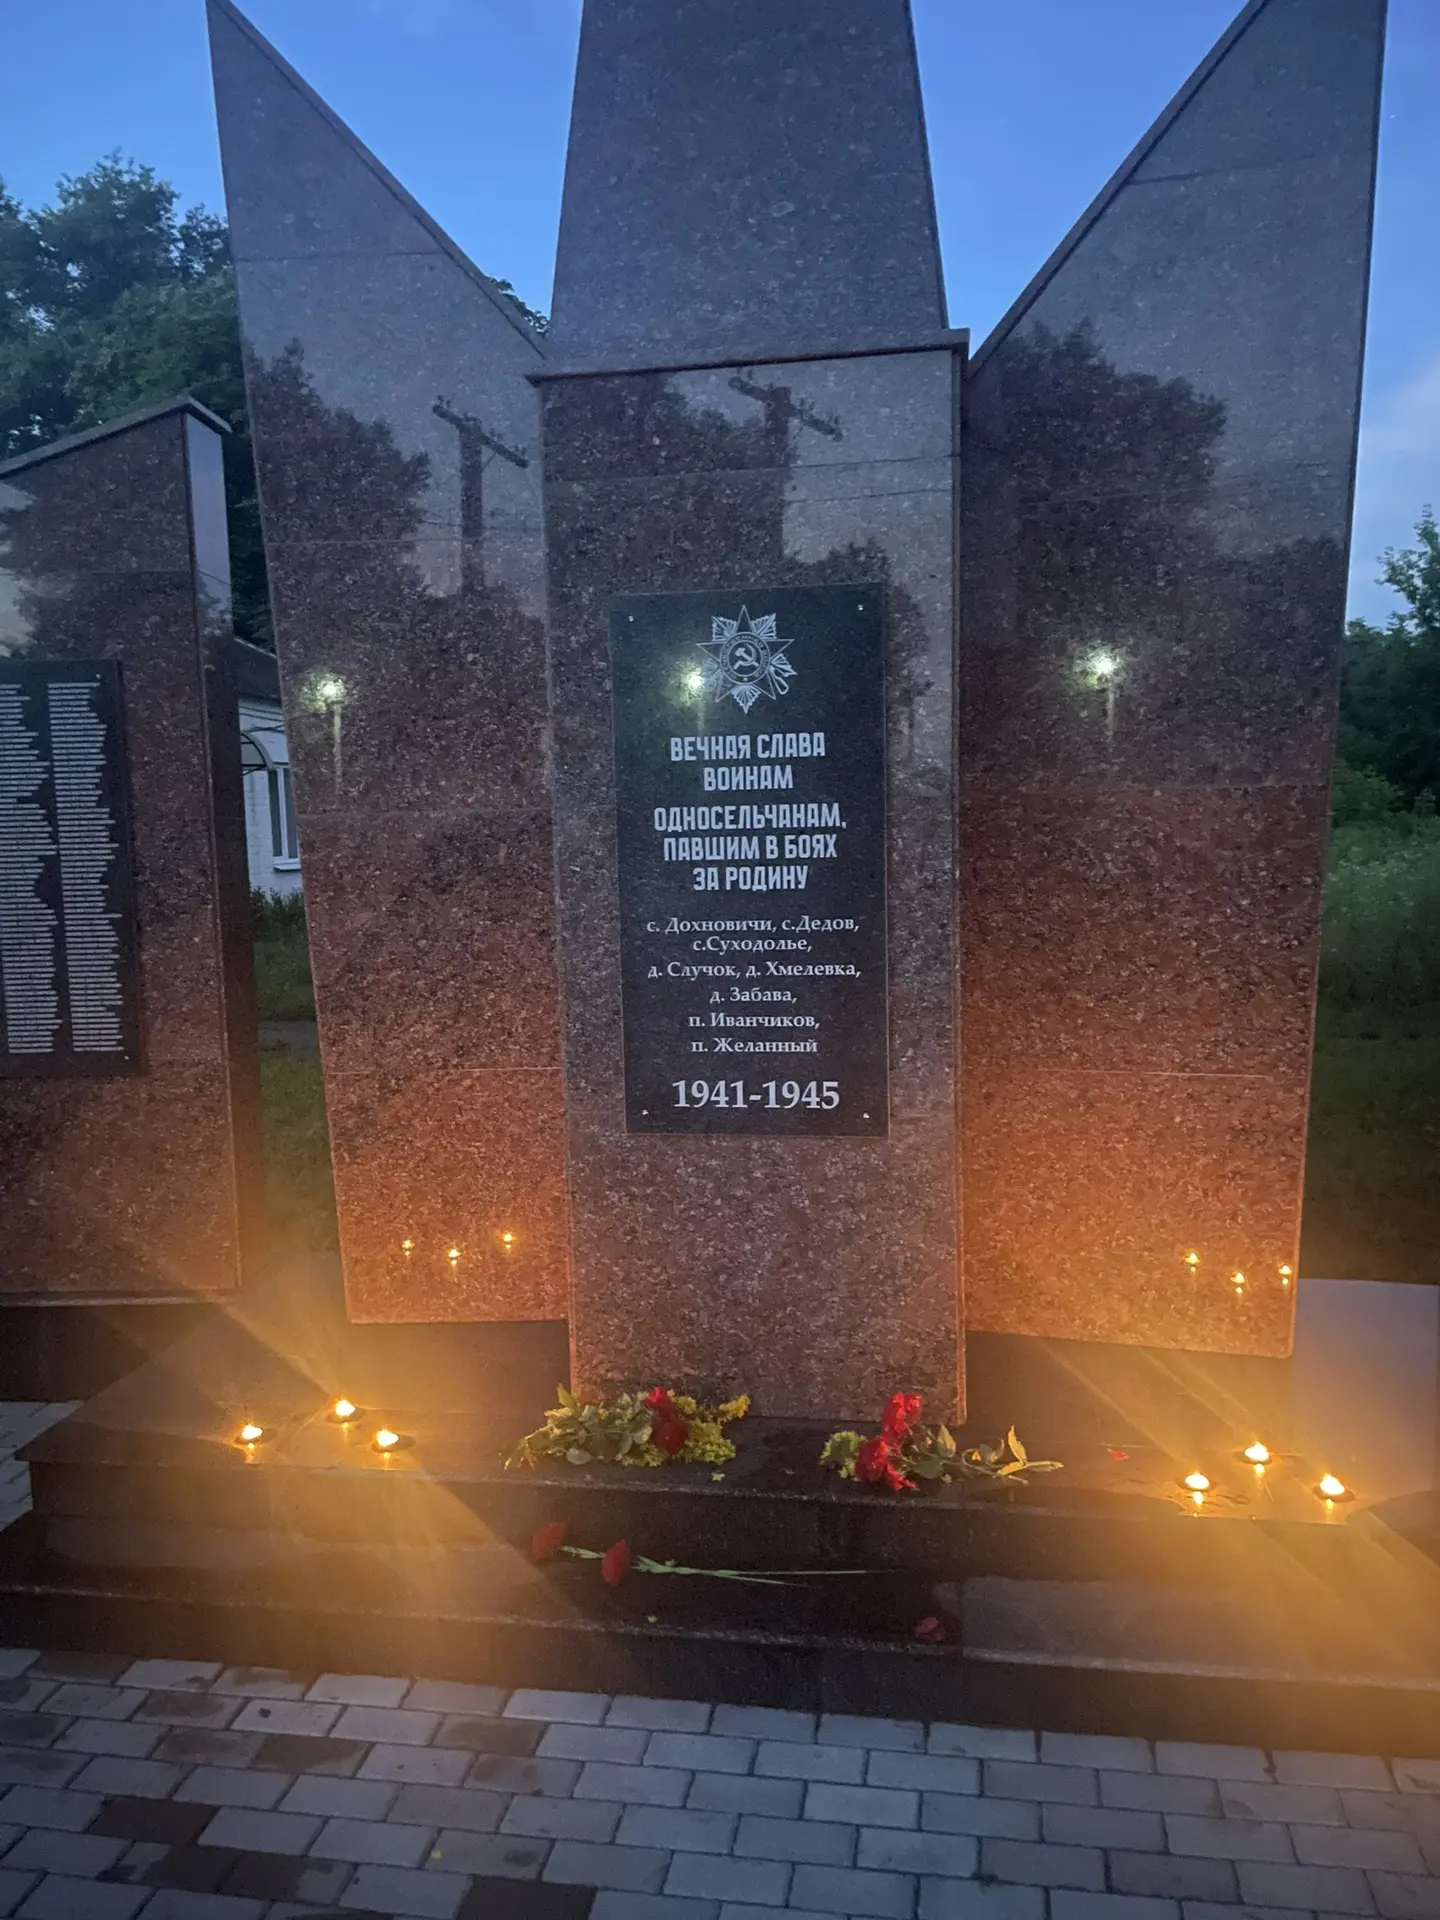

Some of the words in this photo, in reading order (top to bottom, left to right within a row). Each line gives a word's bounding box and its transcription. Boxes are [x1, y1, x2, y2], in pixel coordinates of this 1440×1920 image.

[671, 735, 751, 761] ВЕЧНАЯ
[757, 732, 826, 758] СЛАВА
[703, 765, 794, 791] ВОИНАМ
[654, 803, 847, 832] ОДНОСЕЛЬЧАНАМ,
[664, 836, 760, 861] ПАВШИМ
[766, 836, 779, 859] В
[785, 834, 838, 858] БОЯХ
[693, 867, 720, 891] ЗА
[726, 866, 809, 891] РОДИНУ
[665, 917, 777, 935] Дохновичи,
[667, 961, 741, 981] Случок,
[765, 961, 861, 978] Хмелевка,
[729, 986, 798, 1004] Забава,
[710, 1012, 820, 1030] Иванчиков,
[713, 1037, 818, 1053] Желанный
[672, 1080, 840, 1110] 1941-1945
